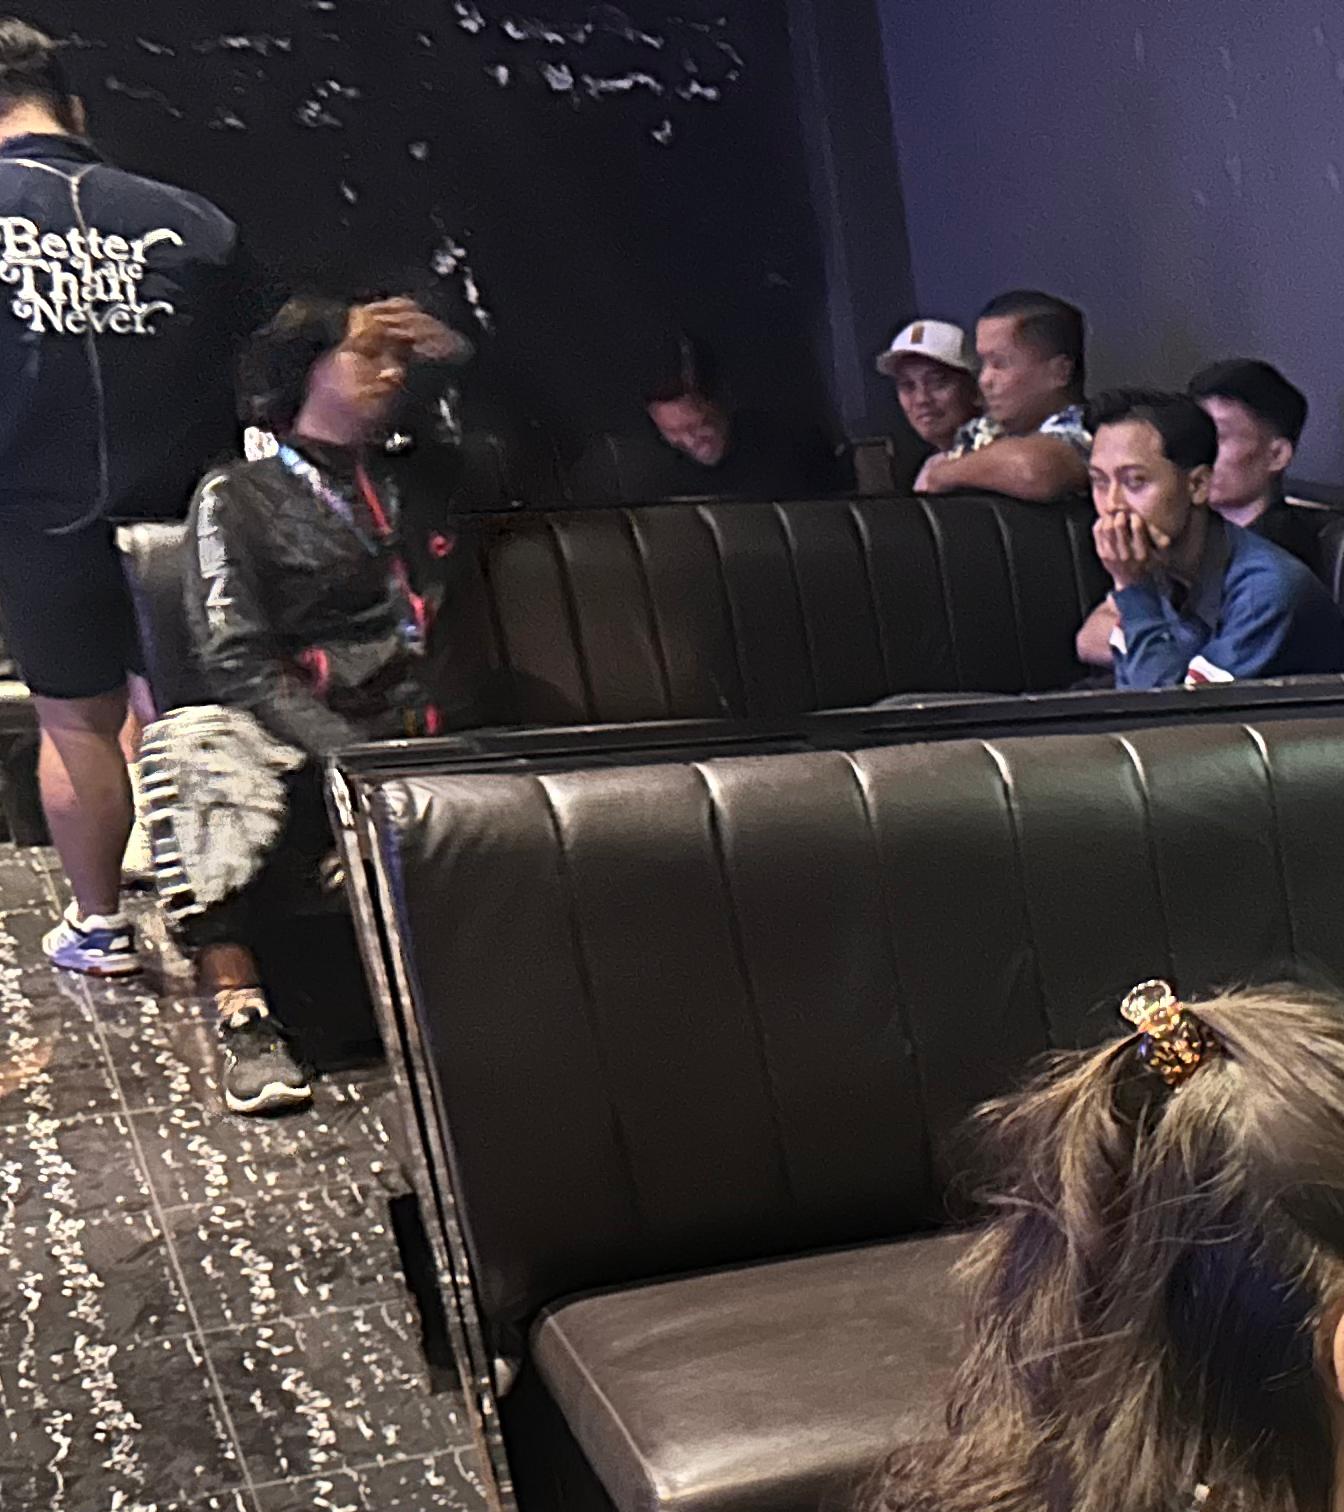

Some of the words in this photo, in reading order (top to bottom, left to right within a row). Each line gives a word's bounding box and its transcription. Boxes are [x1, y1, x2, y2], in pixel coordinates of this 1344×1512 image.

[0, 216, 184, 263] Better
[0, 255, 150, 314] Than
[12, 298, 174, 334] Never.
